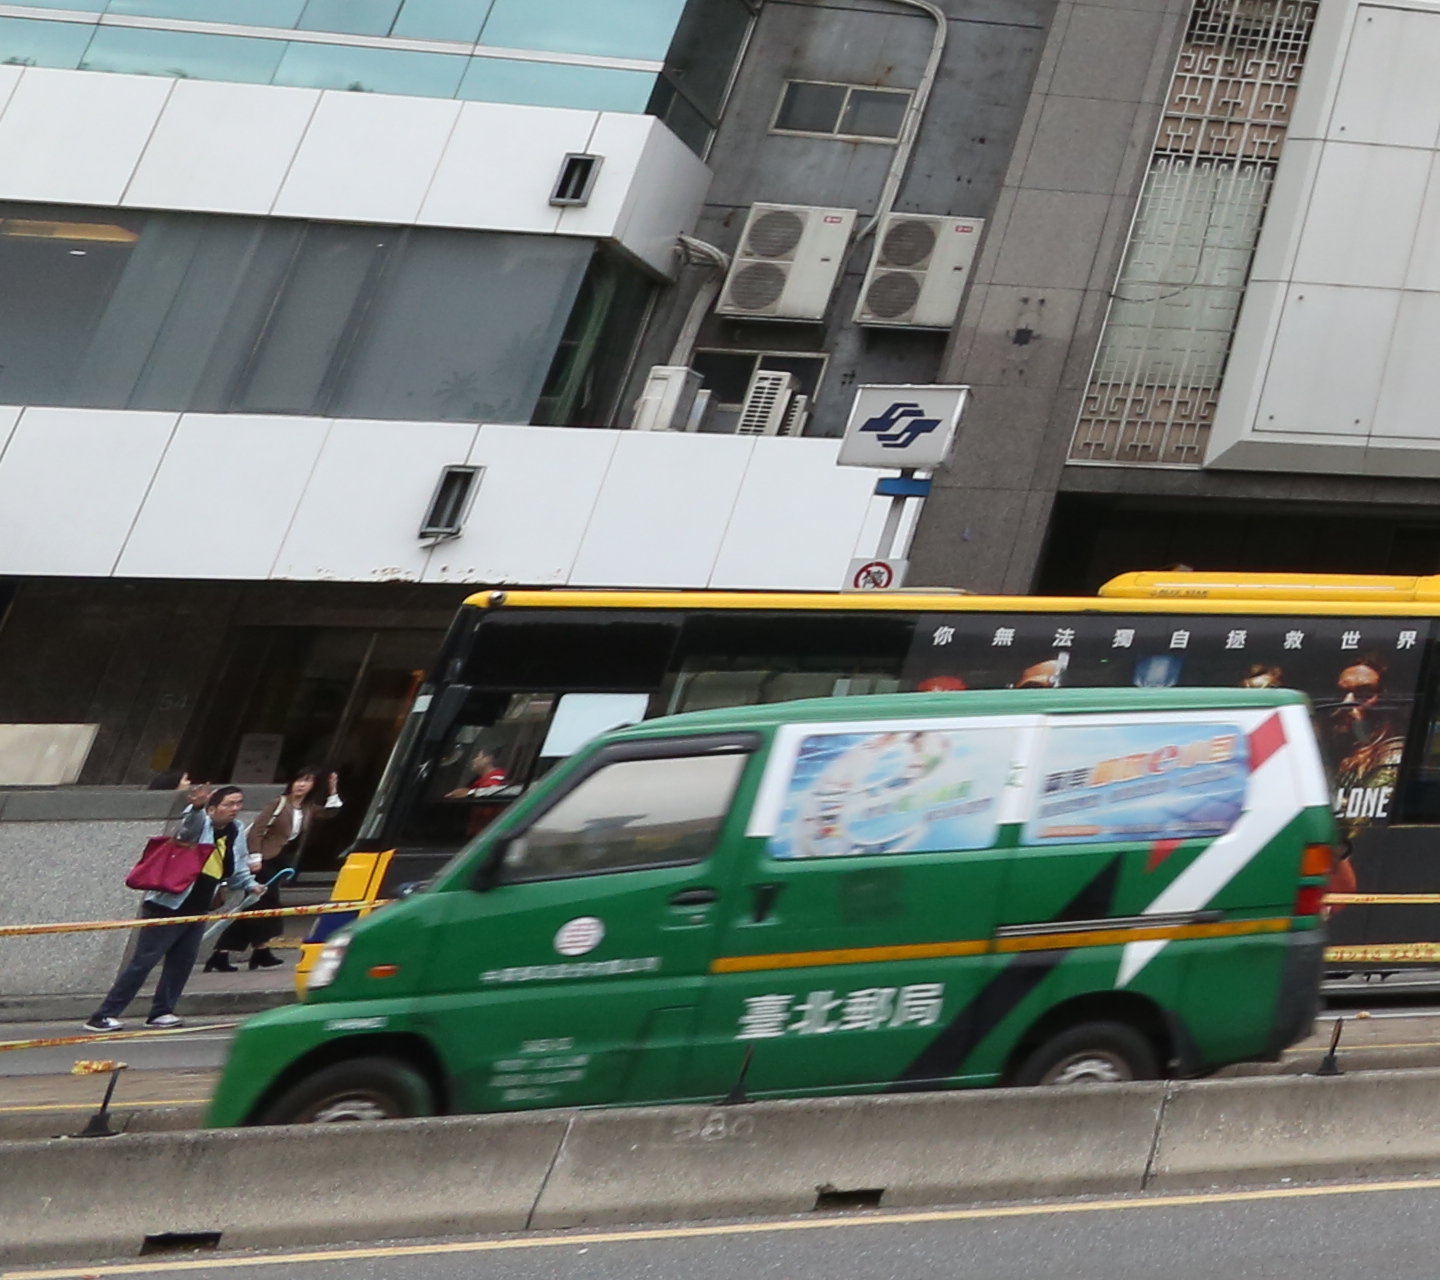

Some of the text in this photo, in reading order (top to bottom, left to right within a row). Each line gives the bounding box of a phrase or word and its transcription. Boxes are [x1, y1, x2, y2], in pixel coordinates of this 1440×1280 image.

[932, 624, 1418, 650] 你無法獨自拯救世界
[733, 982, 947, 1042] 臺北郵局
